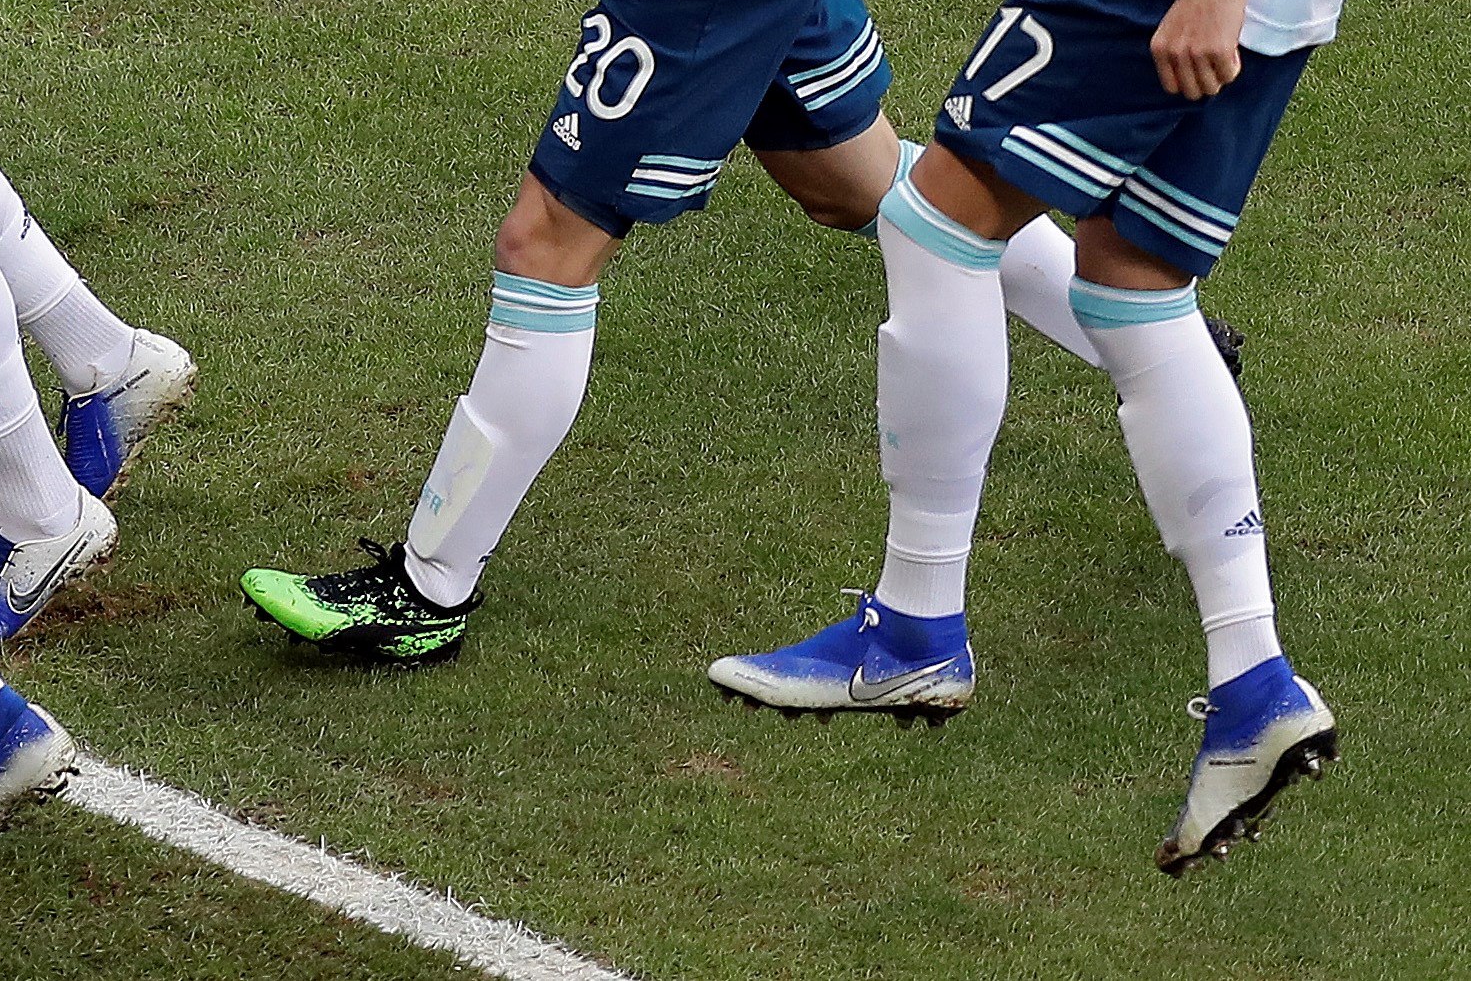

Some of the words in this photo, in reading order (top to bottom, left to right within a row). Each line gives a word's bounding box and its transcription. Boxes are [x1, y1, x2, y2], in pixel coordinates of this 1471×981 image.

[564, 13, 655, 120] 20
[964, 6, 1054, 102] 17
[552, 121, 582, 151] adidas
